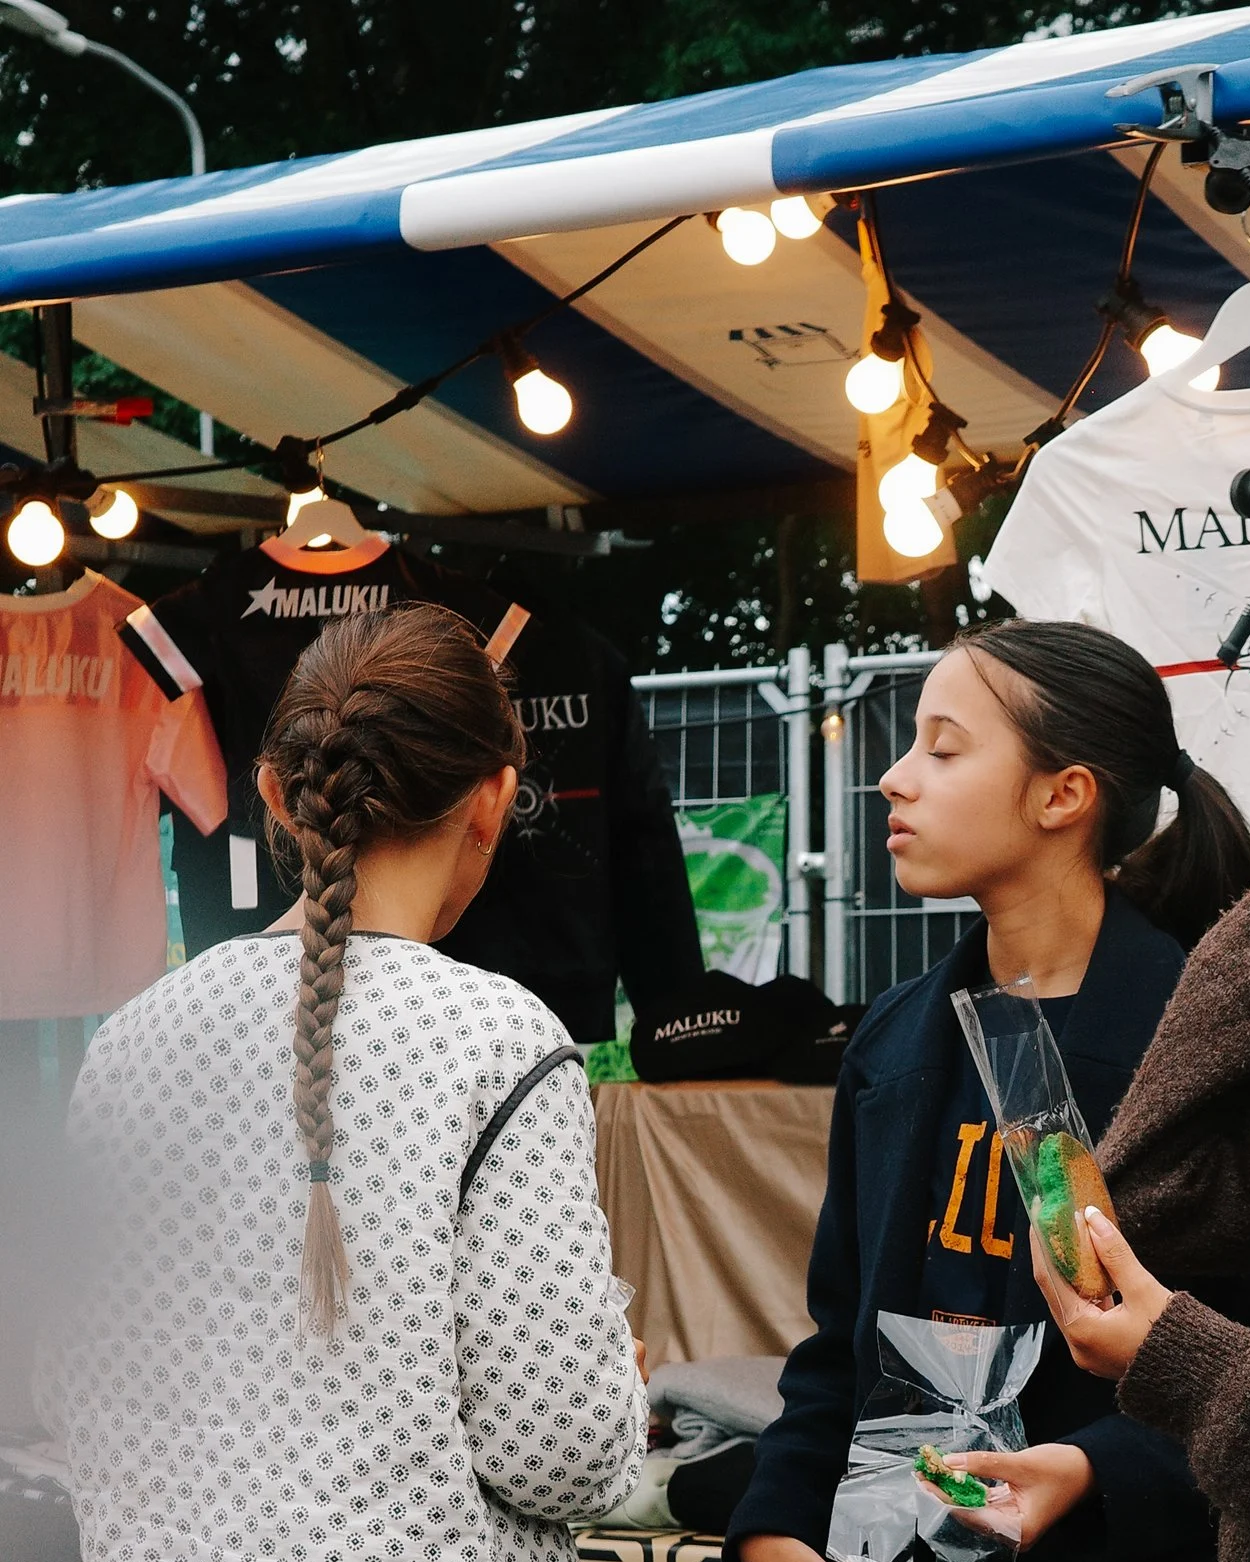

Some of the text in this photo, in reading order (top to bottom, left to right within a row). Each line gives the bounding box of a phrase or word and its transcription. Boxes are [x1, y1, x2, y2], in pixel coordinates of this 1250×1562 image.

[274, 584, 389, 618] MALUKU
[0, 654, 113, 697] ALUKU
[654, 1009, 740, 1041] MALUKU
